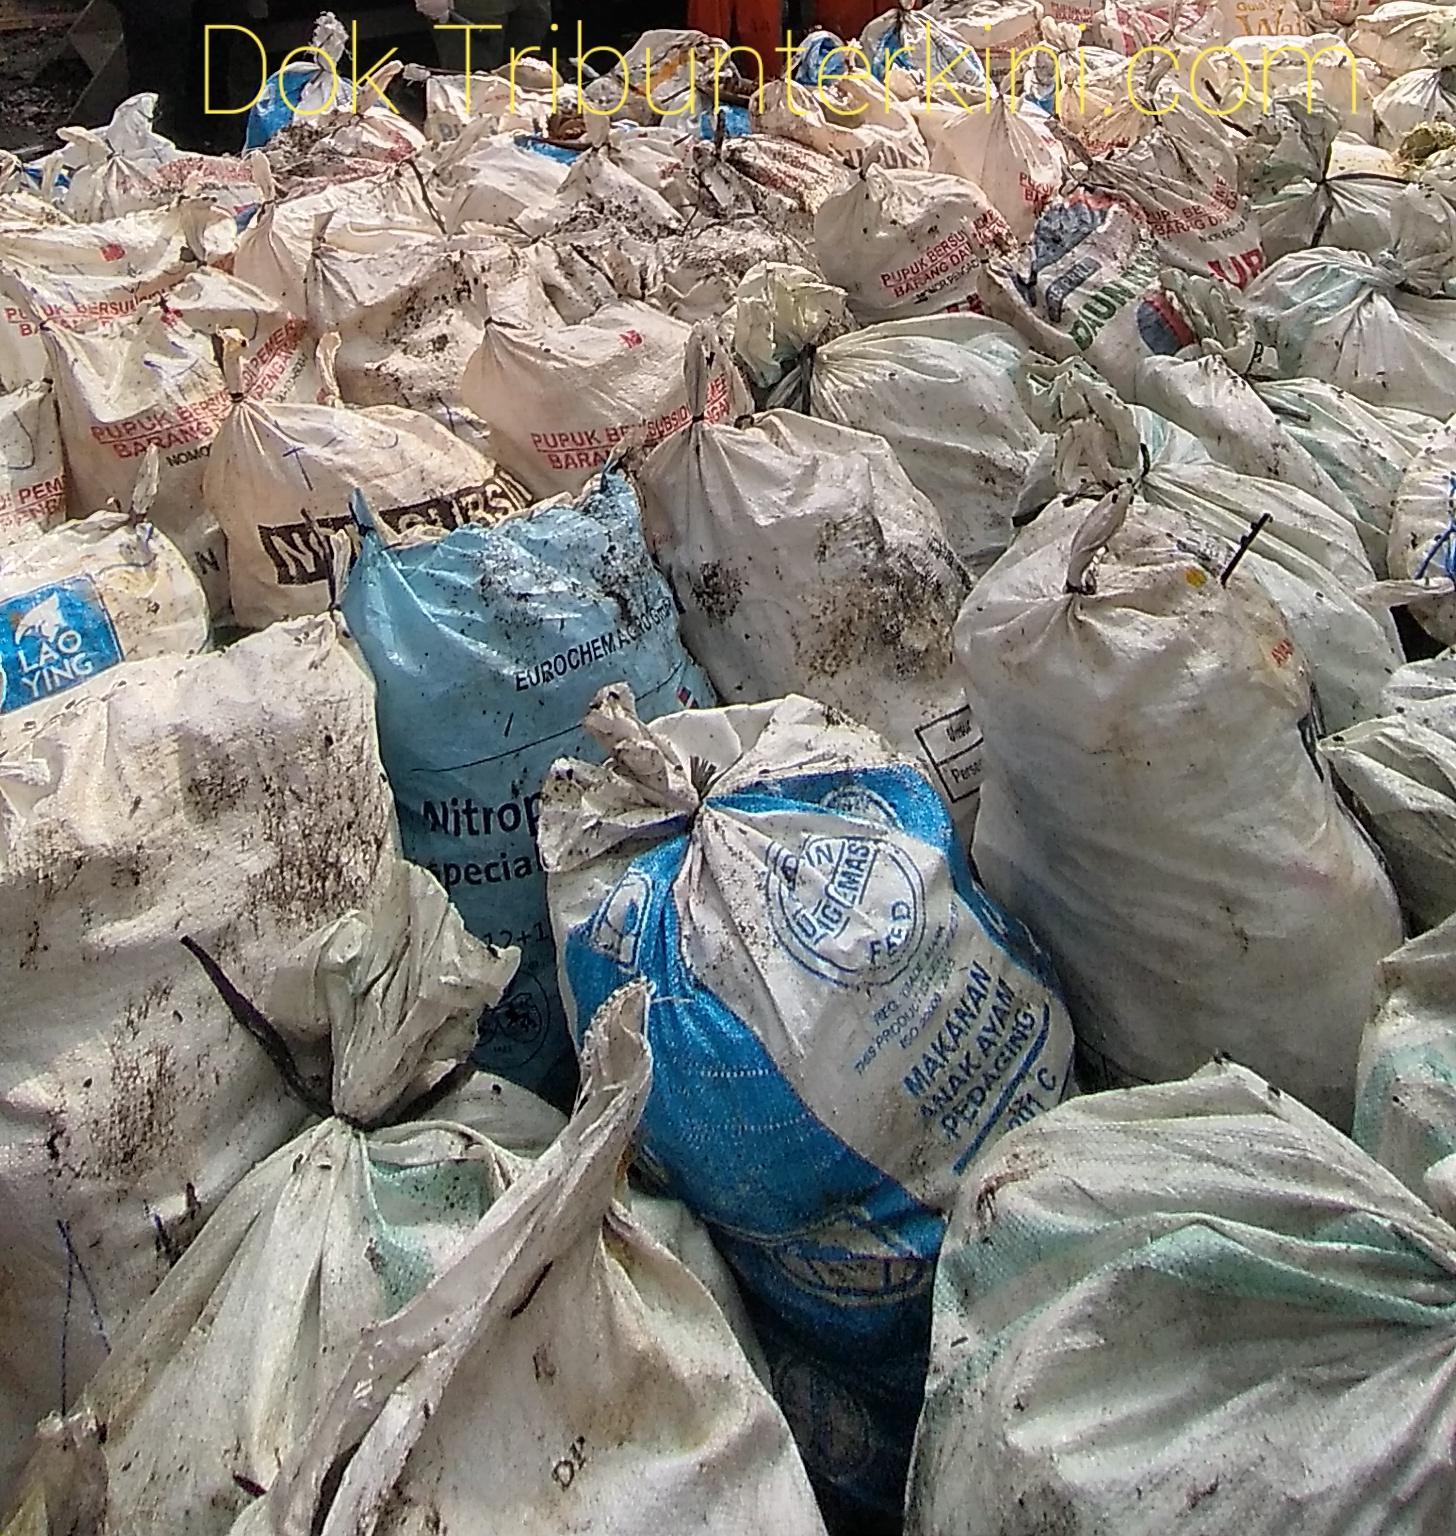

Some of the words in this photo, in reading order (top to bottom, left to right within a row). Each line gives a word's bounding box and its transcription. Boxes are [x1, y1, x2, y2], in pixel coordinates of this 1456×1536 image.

[881, 256, 930, 287] PUPUK
[925, 228, 968, 264] BERSU
[1067, 276, 1137, 352] DAUN
[90, 411, 172, 441] PUPUK
[531, 429, 602, 450] PUPUK
[18, 628, 83, 674] LAO
[21, 651, 93, 698] YING
[515, 632, 617, 692] EUROCHEM
[422, 790, 544, 838] Nitrop
[444, 850, 545, 887] pecial
[899, 1026, 921, 1050] ISO
[903, 959, 992, 1098] MAKANAN
[918, 1049, 982, 1118] ANAK
[975, 976, 1016, 1058] AYAM
[940, 1008, 1037, 1141] PEDAGING
